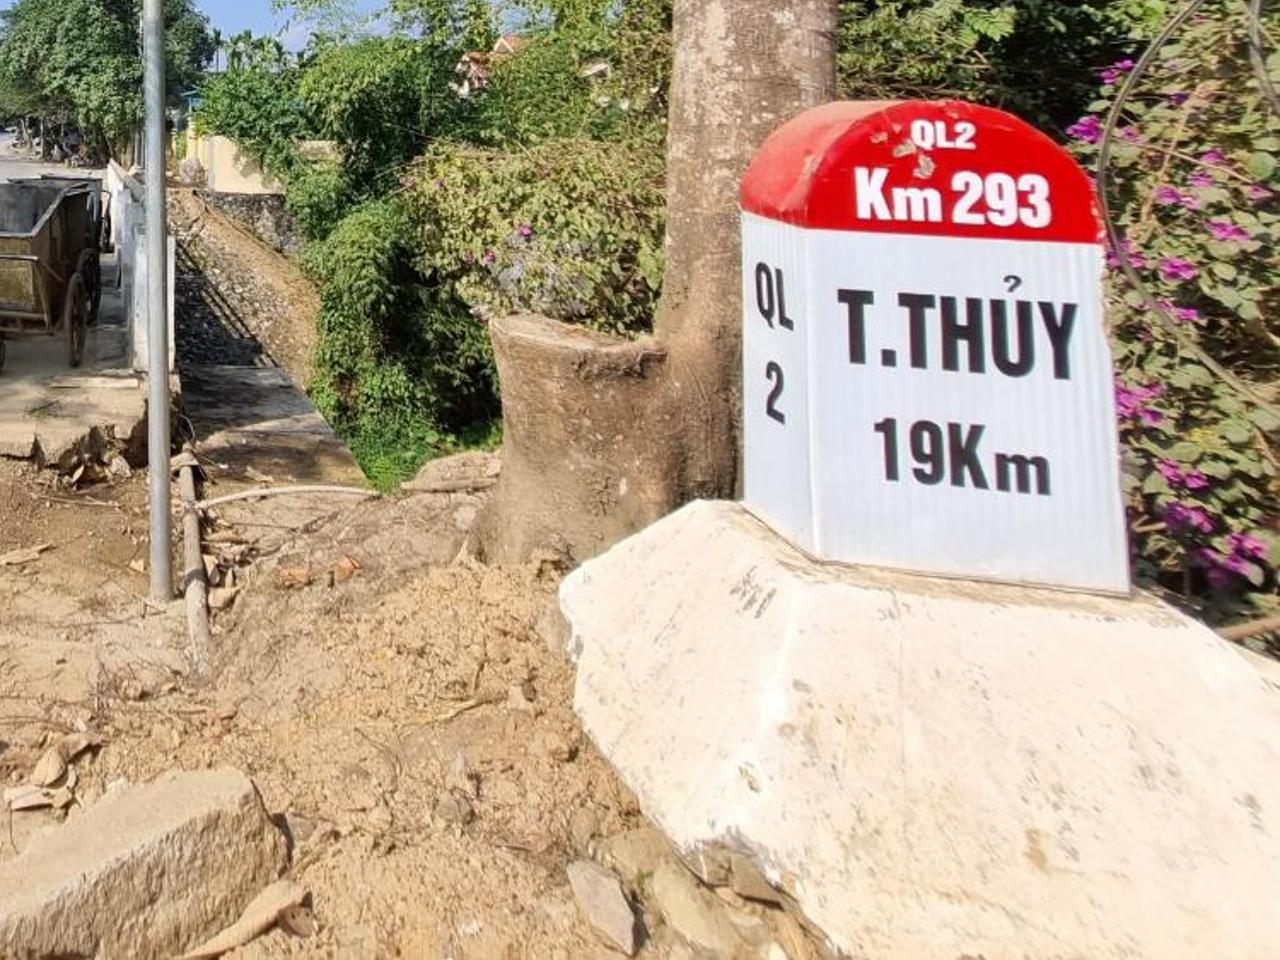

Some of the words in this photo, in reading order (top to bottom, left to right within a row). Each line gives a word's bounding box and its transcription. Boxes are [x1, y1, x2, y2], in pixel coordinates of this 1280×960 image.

[910, 119, 977, 150] QL2
[854, 166, 943, 223] Km
[951, 171, 1052, 228] 293
[755, 262, 794, 331] QL
[837, 275, 1079, 381] T.THỦY
[765, 361, 787, 426] 2
[873, 416, 1052, 497] 19Km
